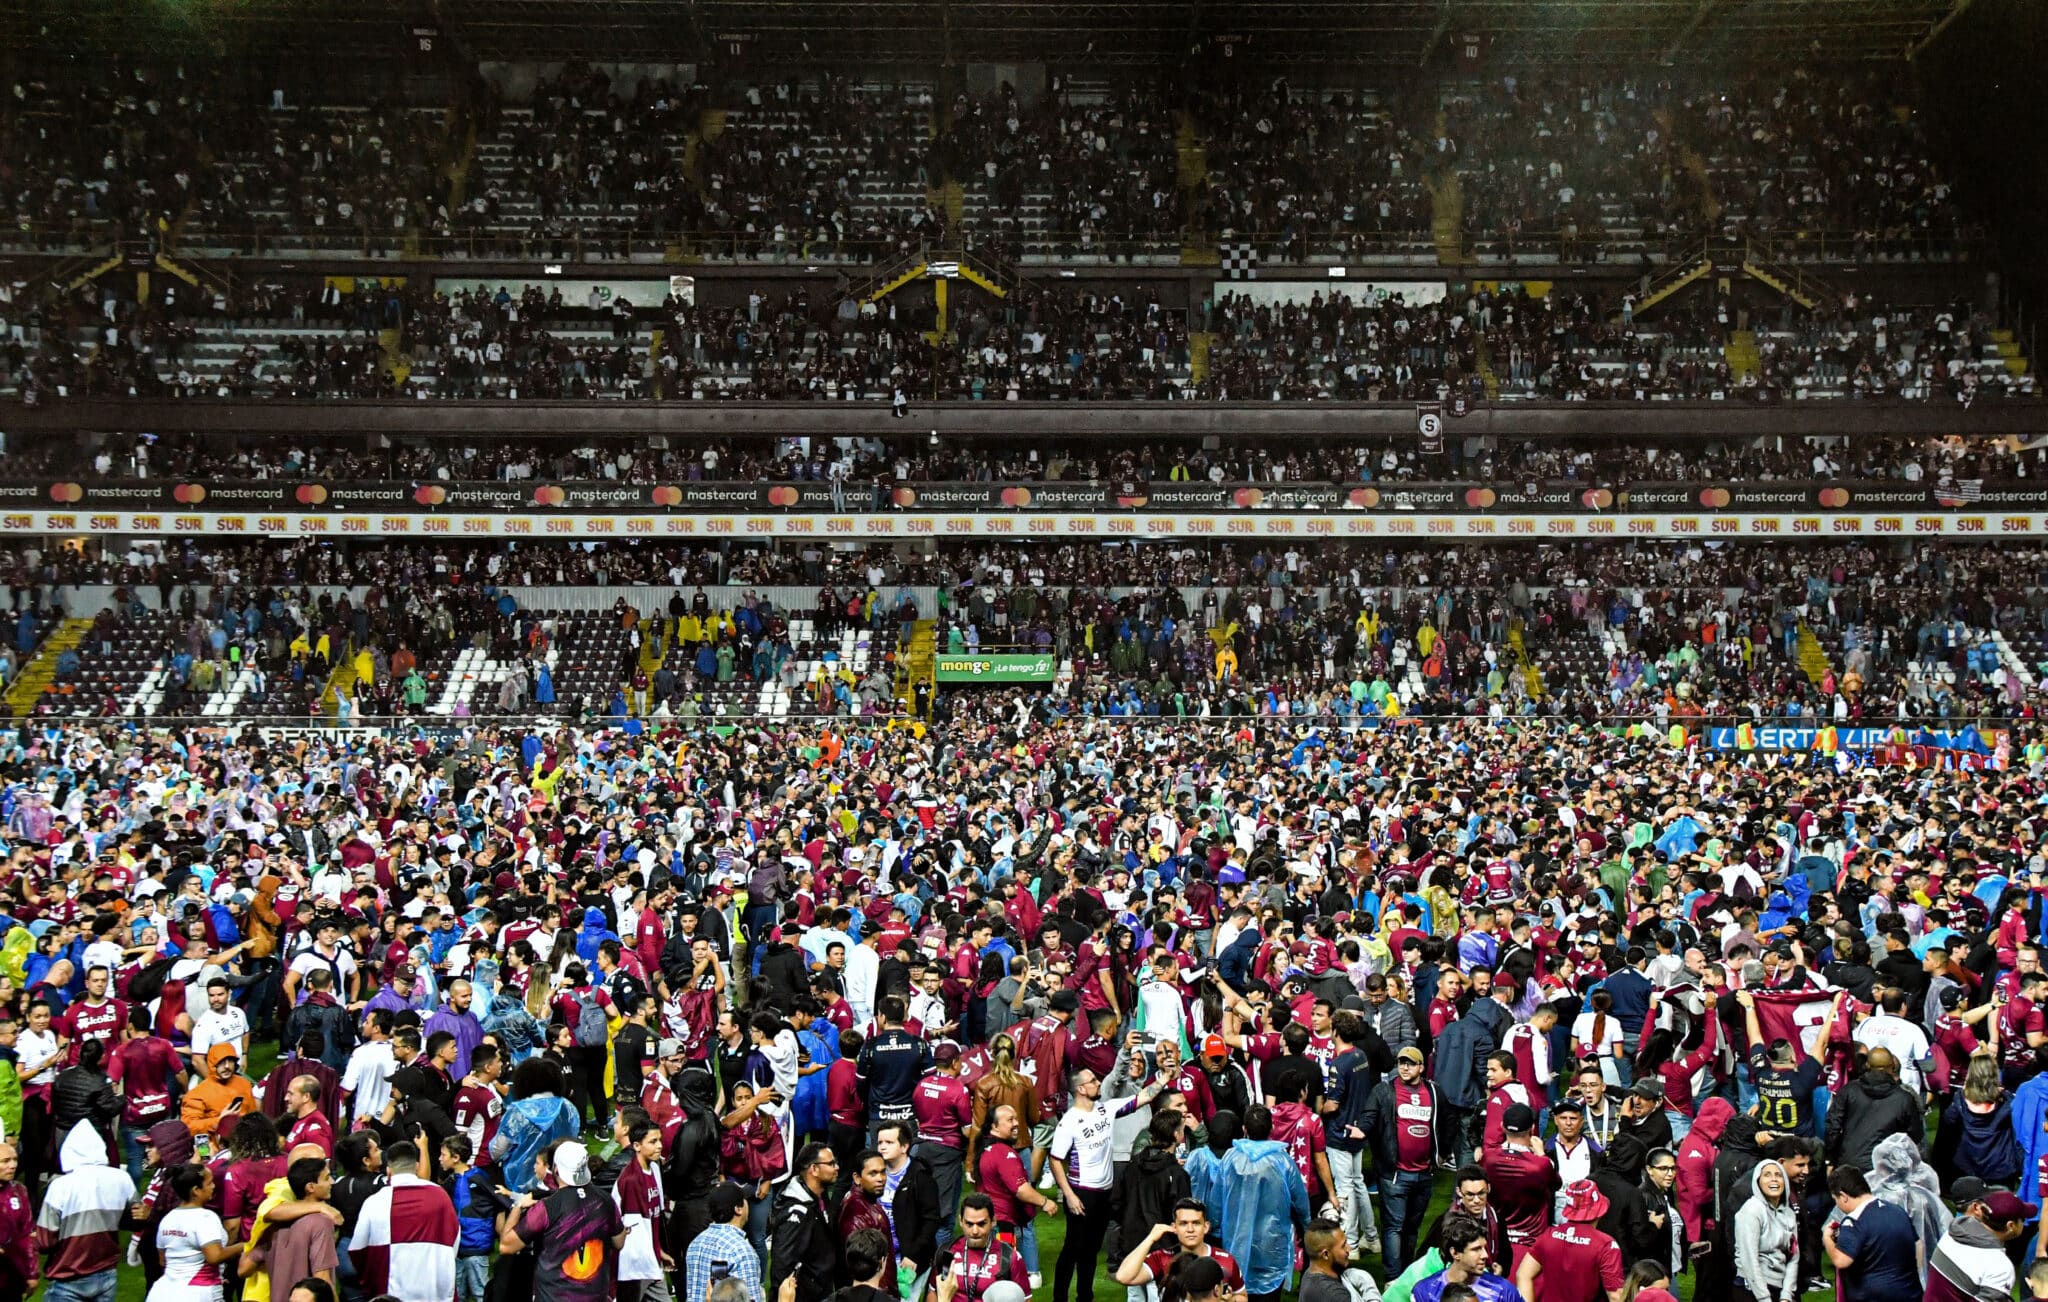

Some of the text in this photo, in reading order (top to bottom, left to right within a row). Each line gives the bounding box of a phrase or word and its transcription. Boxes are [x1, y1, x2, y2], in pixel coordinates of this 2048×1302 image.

[1465, 46, 1478, 58] 10
[1425, 419, 1435, 432] S
[0, 486, 38, 497] ercard
[88, 486, 161, 498] mastercard
[211, 488, 283, 499] mastercard
[332, 489, 403, 500] mastercard
[451, 489, 521, 501] mastercard
[569, 489, 639, 501] mastercard
[688, 490, 757, 501] mastercard
[920, 490, 989, 502] mastercard
[1036, 491, 1105, 502] mastercard
[1153, 491, 1221, 502] mastercard
[1268, 491, 1337, 502] mastercard
[1384, 491, 1453, 502] mastercard
[1630, 491, 1688, 502] astercard
[1736, 491, 1805, 502] mastercard
[1854, 491, 1925, 502] mastercard
[4, 517, 2029, 532] SUR SUR SUR SUR SUR SUR SUR SUR SUR SUR SUR SUR SUR SUR SUR SUR SUR SUR SUR SUR SUR SUR SUR SUR SUR SUR SUR SUR SUR SUR SUR SUR SUR SUR SUR SUR SUR SUR SUR SUR SUR SUR SUR SUR SUR SUR SUR SUR SUR SUR
[941, 661, 991, 674] monge
[1009, 664, 1034, 673] tengo
[407, 965, 415, 974] S
[107, 1005, 116, 1014] S
[231, 1010, 239, 1019] S
[1181, 1077, 1194, 1091] S
[1411, 1094, 1420, 1106] S
[879, 1108, 914, 1120] Claro
[1098, 1106, 1106, 1116] S
[1760, 1095, 1797, 1128] 20
[1094, 1118, 1111, 1132] BAC
[577, 1188, 586, 1199] S
[10, 1197, 20, 1210] S
[988, 1254, 998, 1265] S
